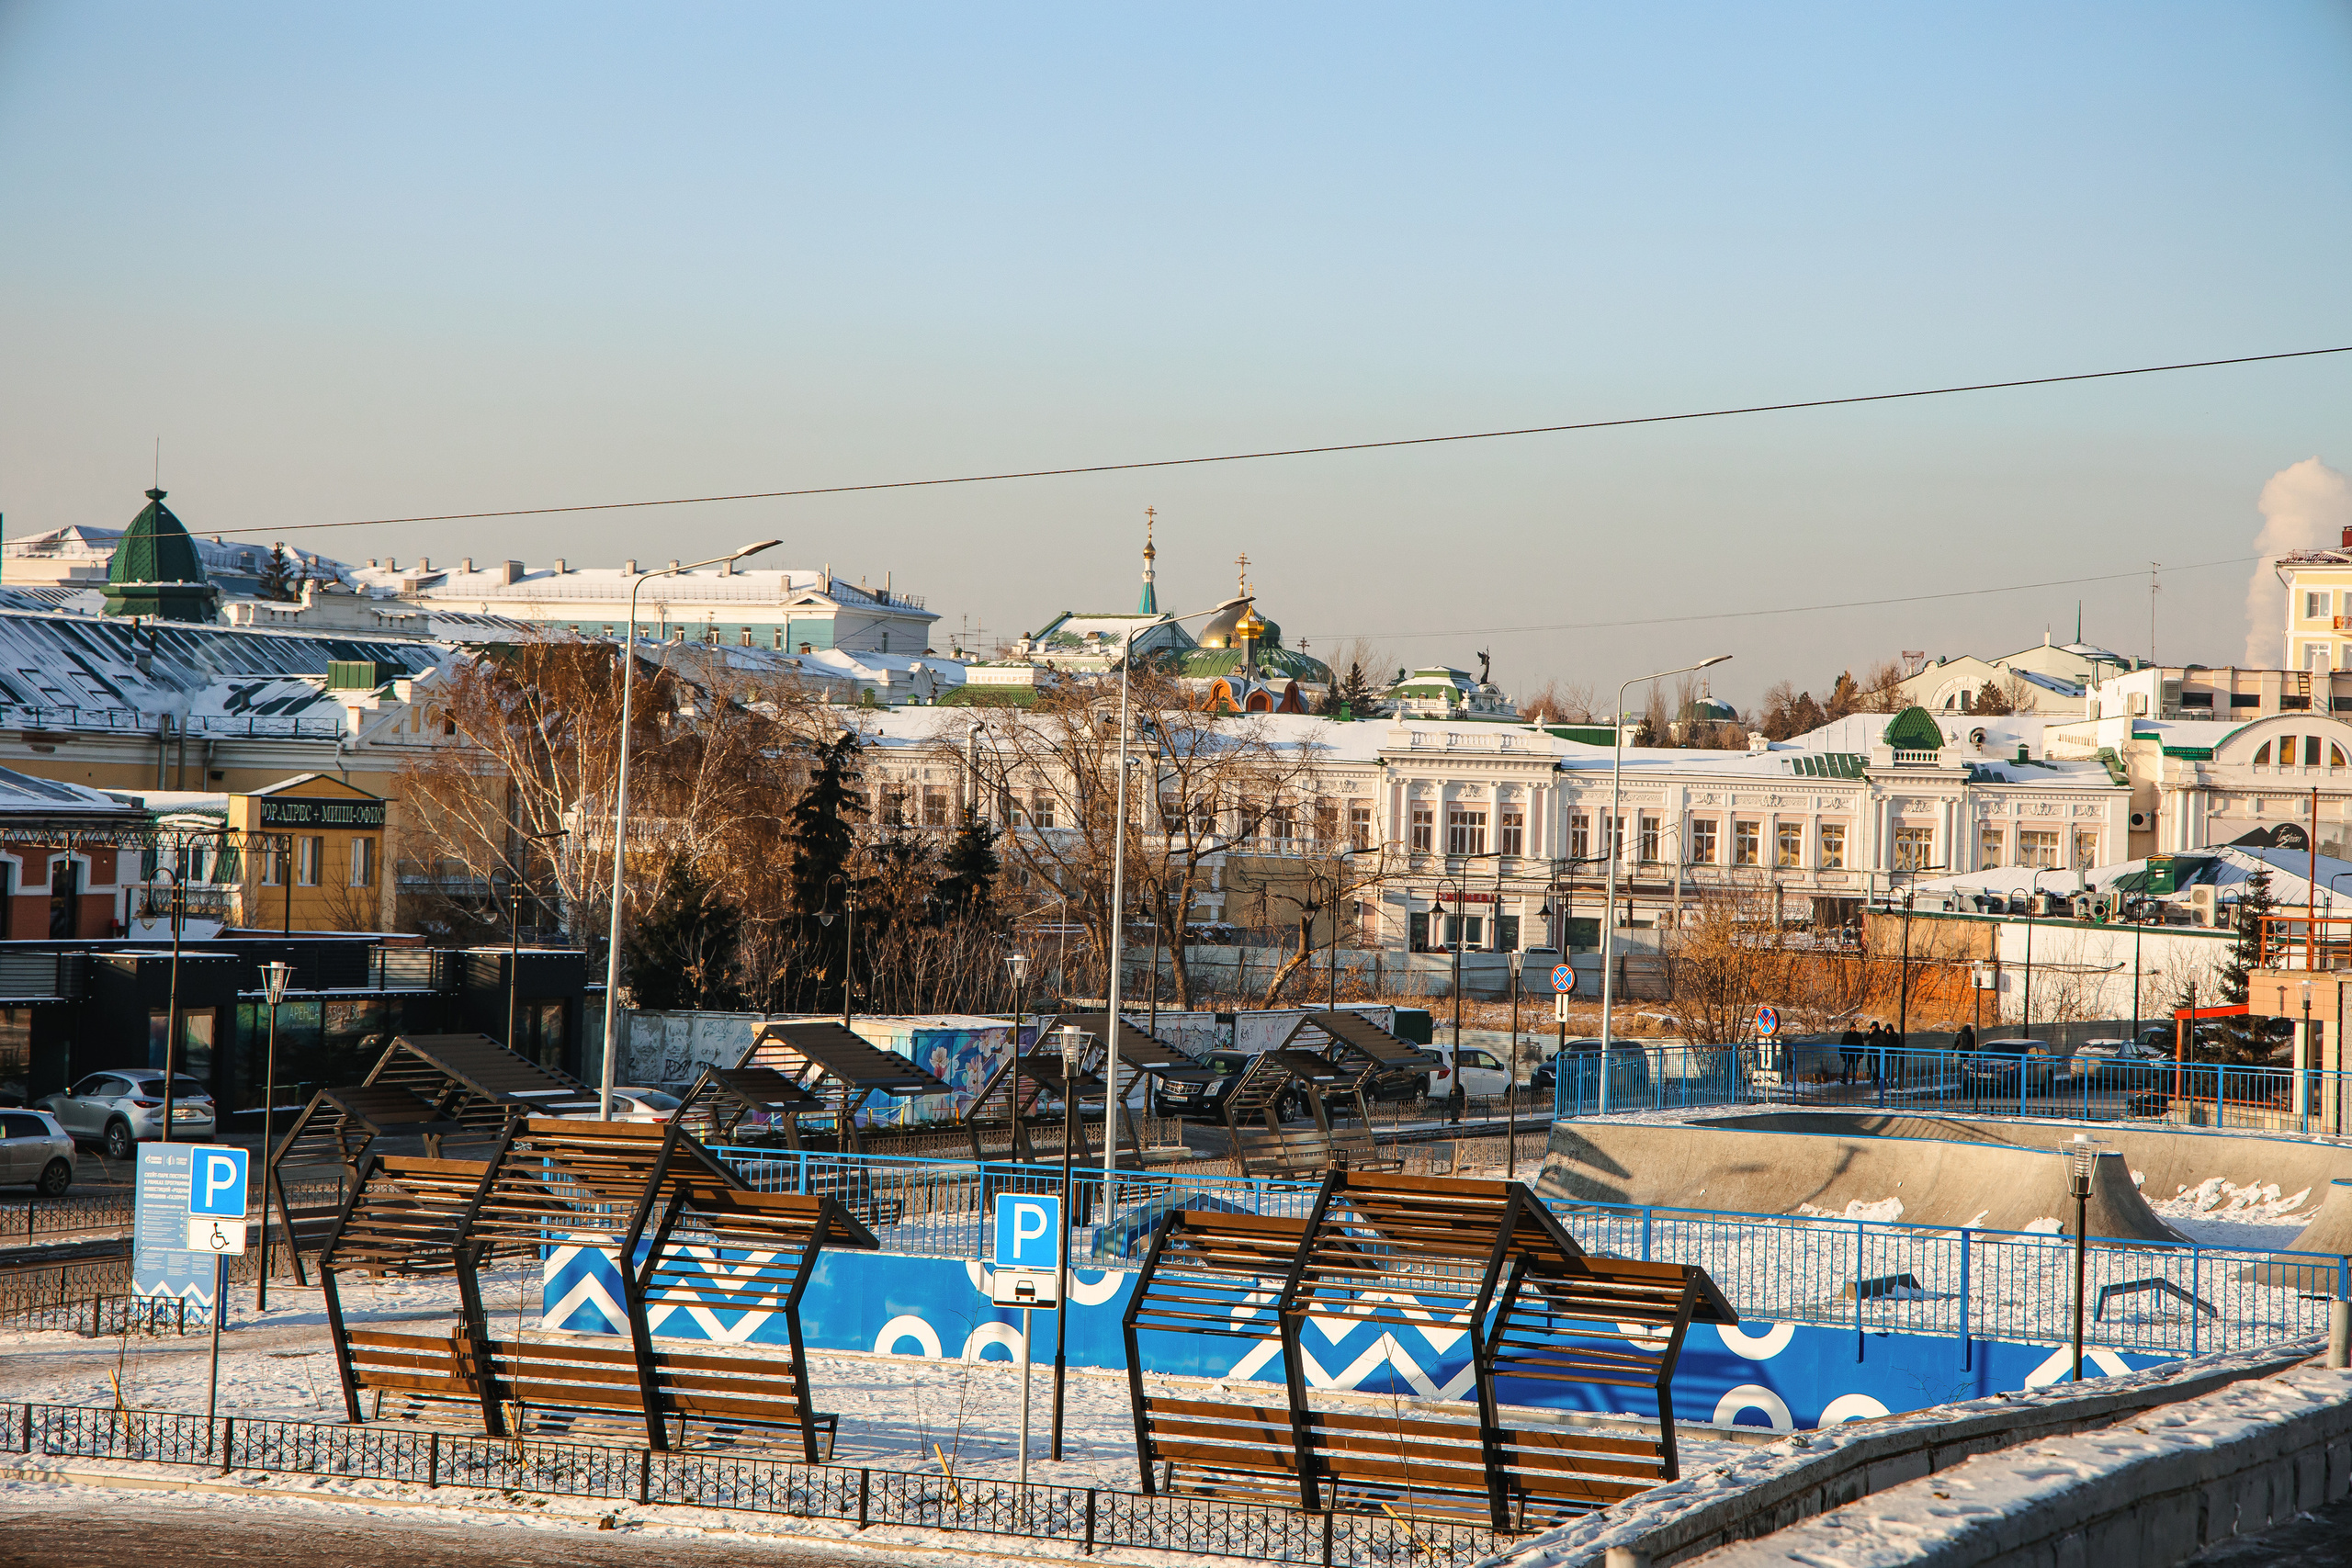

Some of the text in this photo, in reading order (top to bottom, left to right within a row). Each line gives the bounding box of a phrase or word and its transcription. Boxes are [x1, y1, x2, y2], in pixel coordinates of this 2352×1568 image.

[322, 805, 385, 824] МИНИ-ОФИС
[288, 1004, 361, 1021] АРЕНДА 339-236
[205, 1155, 238, 1208] P
[1012, 1202, 1048, 1259] P
